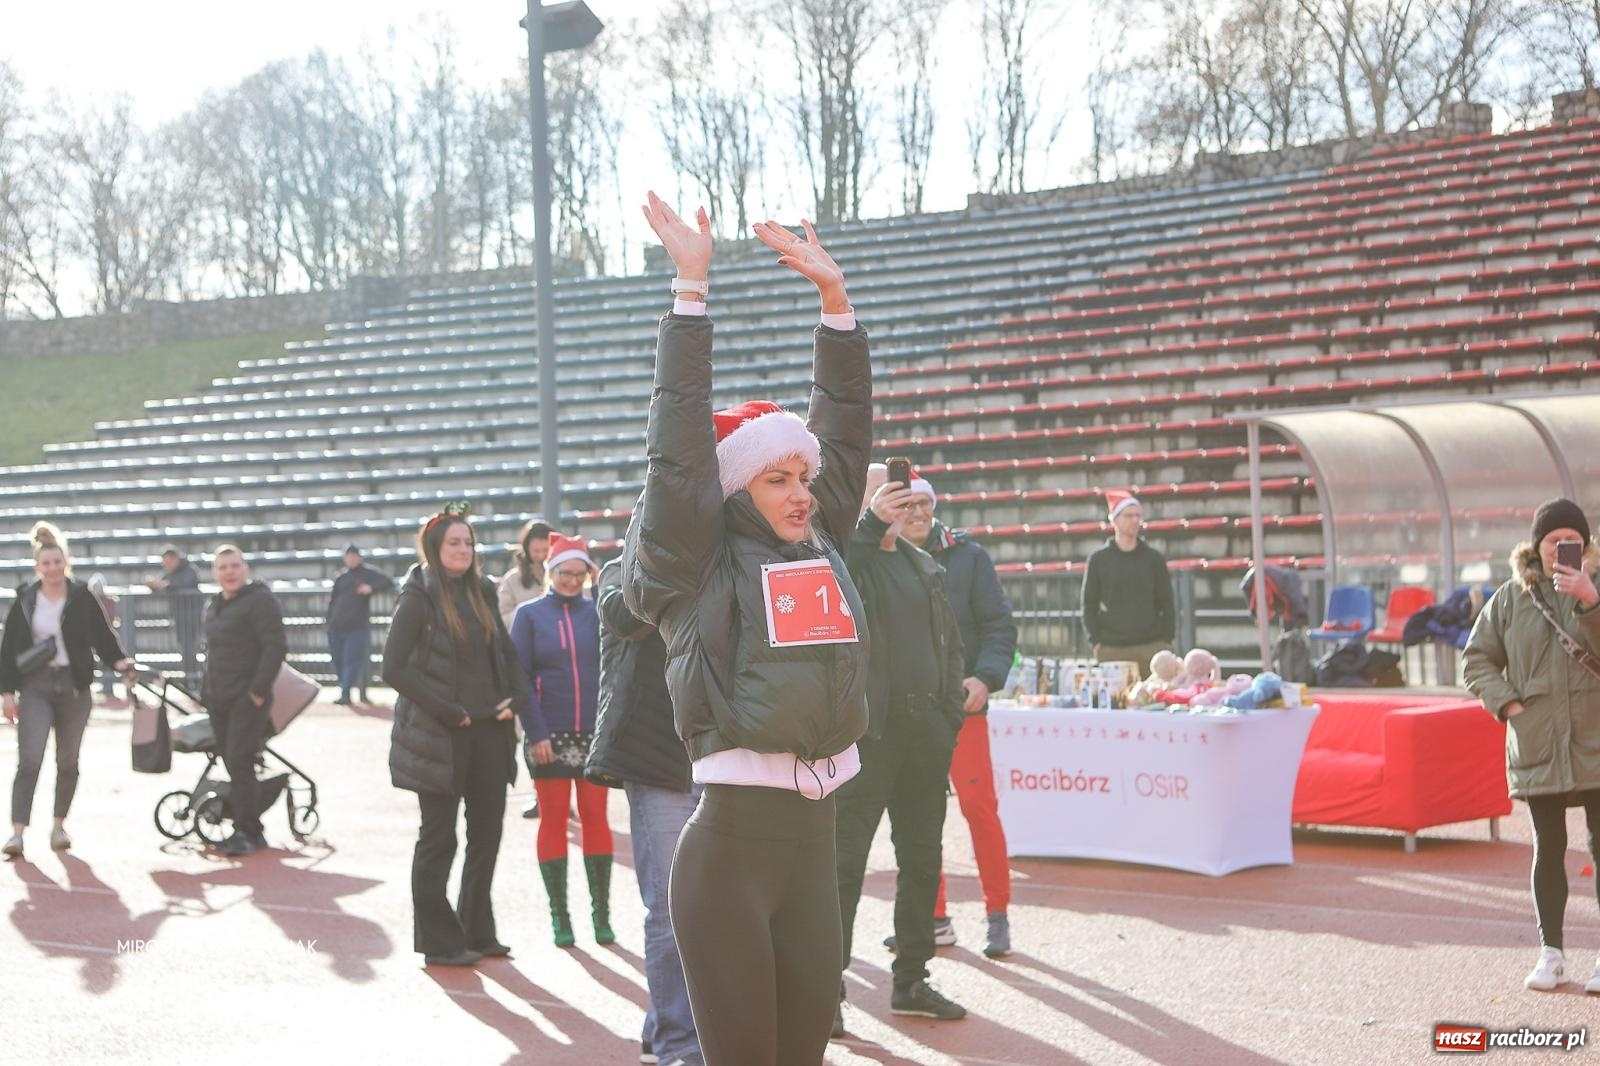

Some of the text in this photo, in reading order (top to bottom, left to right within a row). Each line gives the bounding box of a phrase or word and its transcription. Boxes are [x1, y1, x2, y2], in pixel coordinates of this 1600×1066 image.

[815, 585, 829, 615] 1
[1010, 769, 1189, 800] Racibórz OSiR
